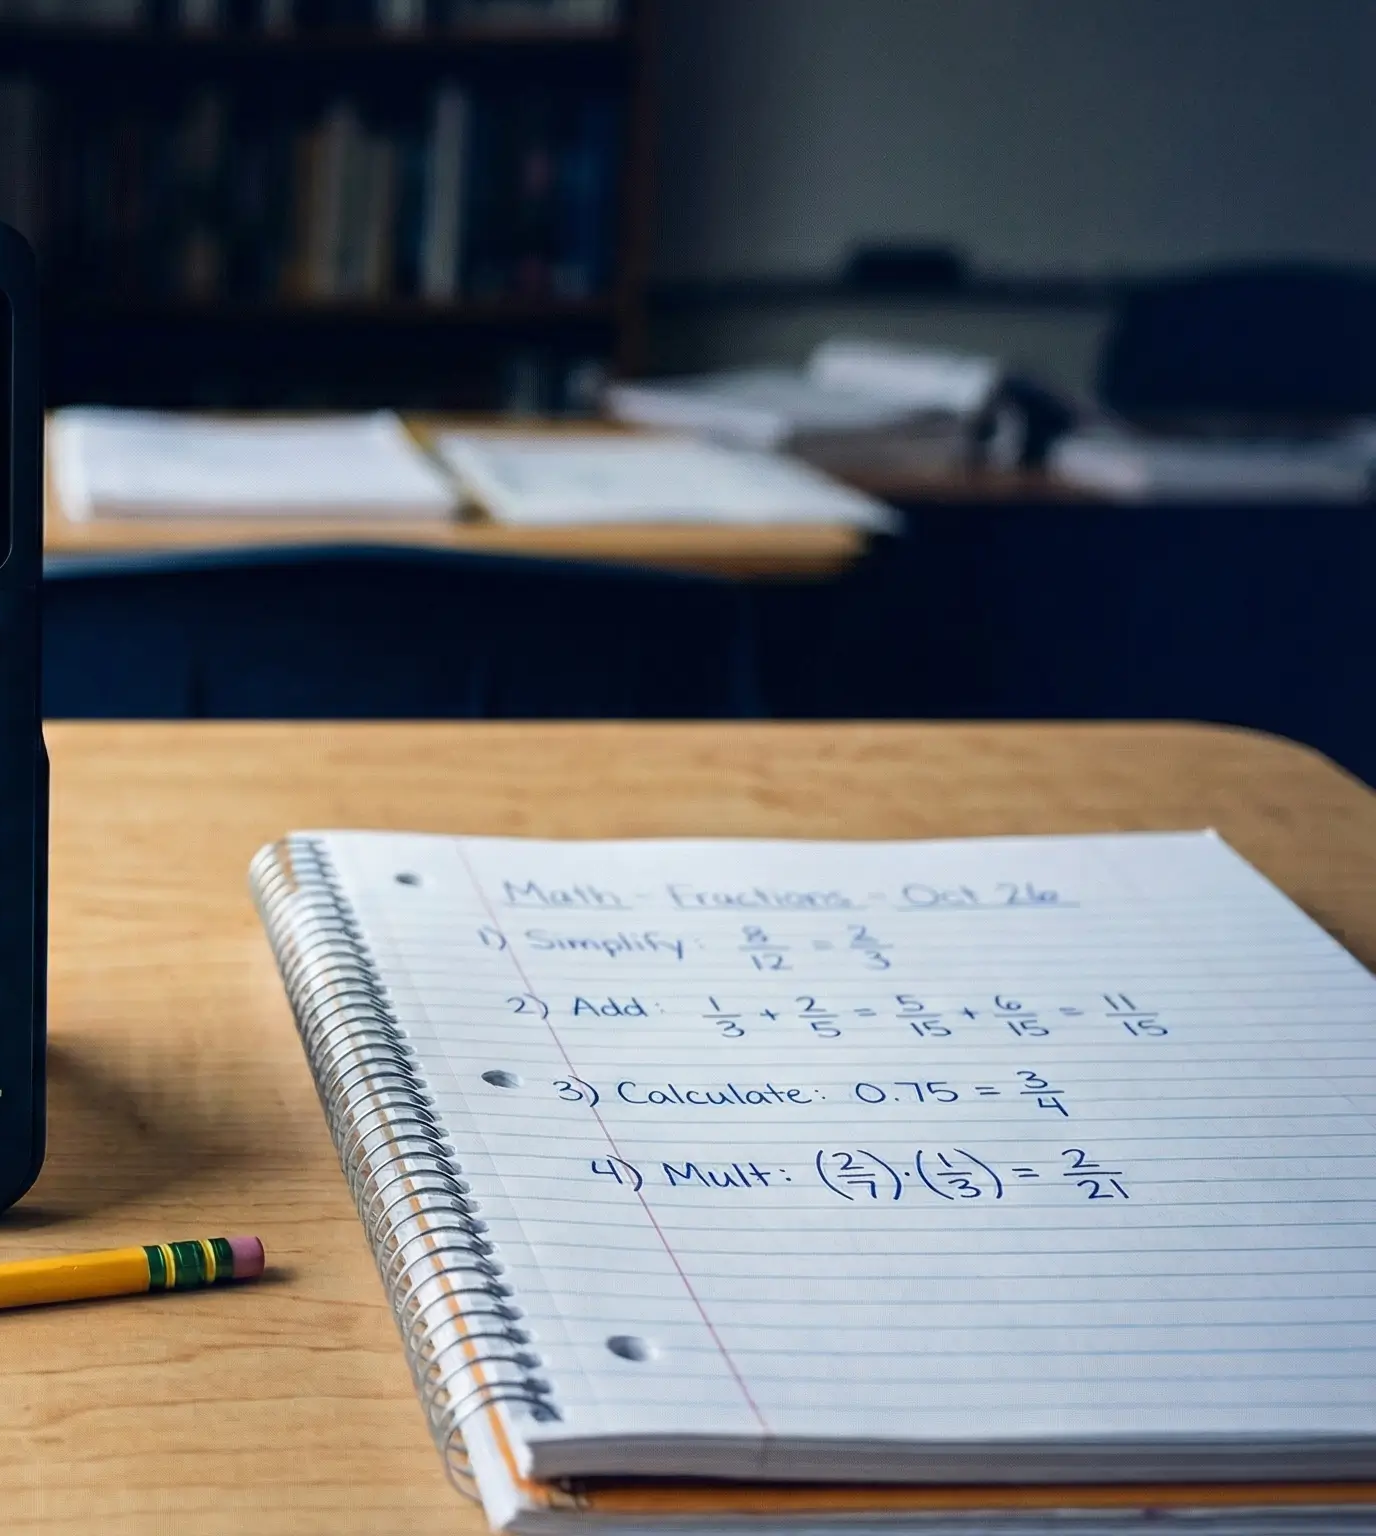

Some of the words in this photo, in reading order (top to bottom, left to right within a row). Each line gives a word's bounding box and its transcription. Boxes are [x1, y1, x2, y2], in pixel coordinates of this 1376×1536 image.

[715, 1020, 747, 1038] 3
[911, 1020, 952, 1037] 15
[1007, 1020, 1050, 1037] 15
[1123, 1020, 1169, 1037] 15
[854, 1081, 959, 1104] 0.75
[1016, 1070, 1049, 1089] 3
[1037, 1097, 1070, 1117] 4
